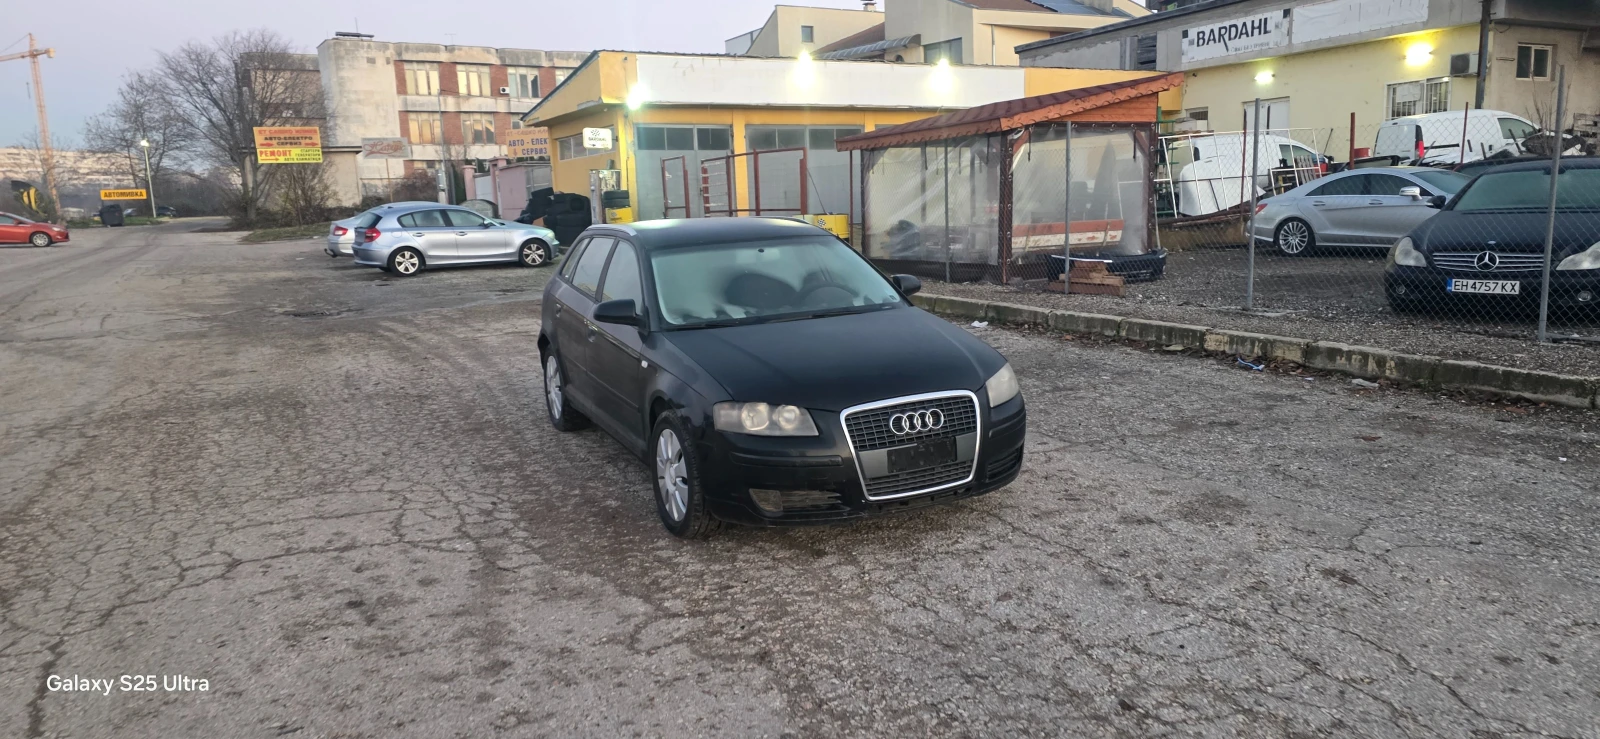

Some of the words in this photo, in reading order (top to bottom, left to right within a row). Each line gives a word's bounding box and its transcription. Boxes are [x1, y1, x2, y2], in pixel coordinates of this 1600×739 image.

[1196, 17, 1272, 52] BARDAHL
[508, 139, 525, 147] АВТО
[521, 147, 547, 155] СЕРВИЗ
[1454, 281, 1468, 290] EH
[1470, 281, 1499, 292] 4757
[1501, 282, 1517, 293] KX
